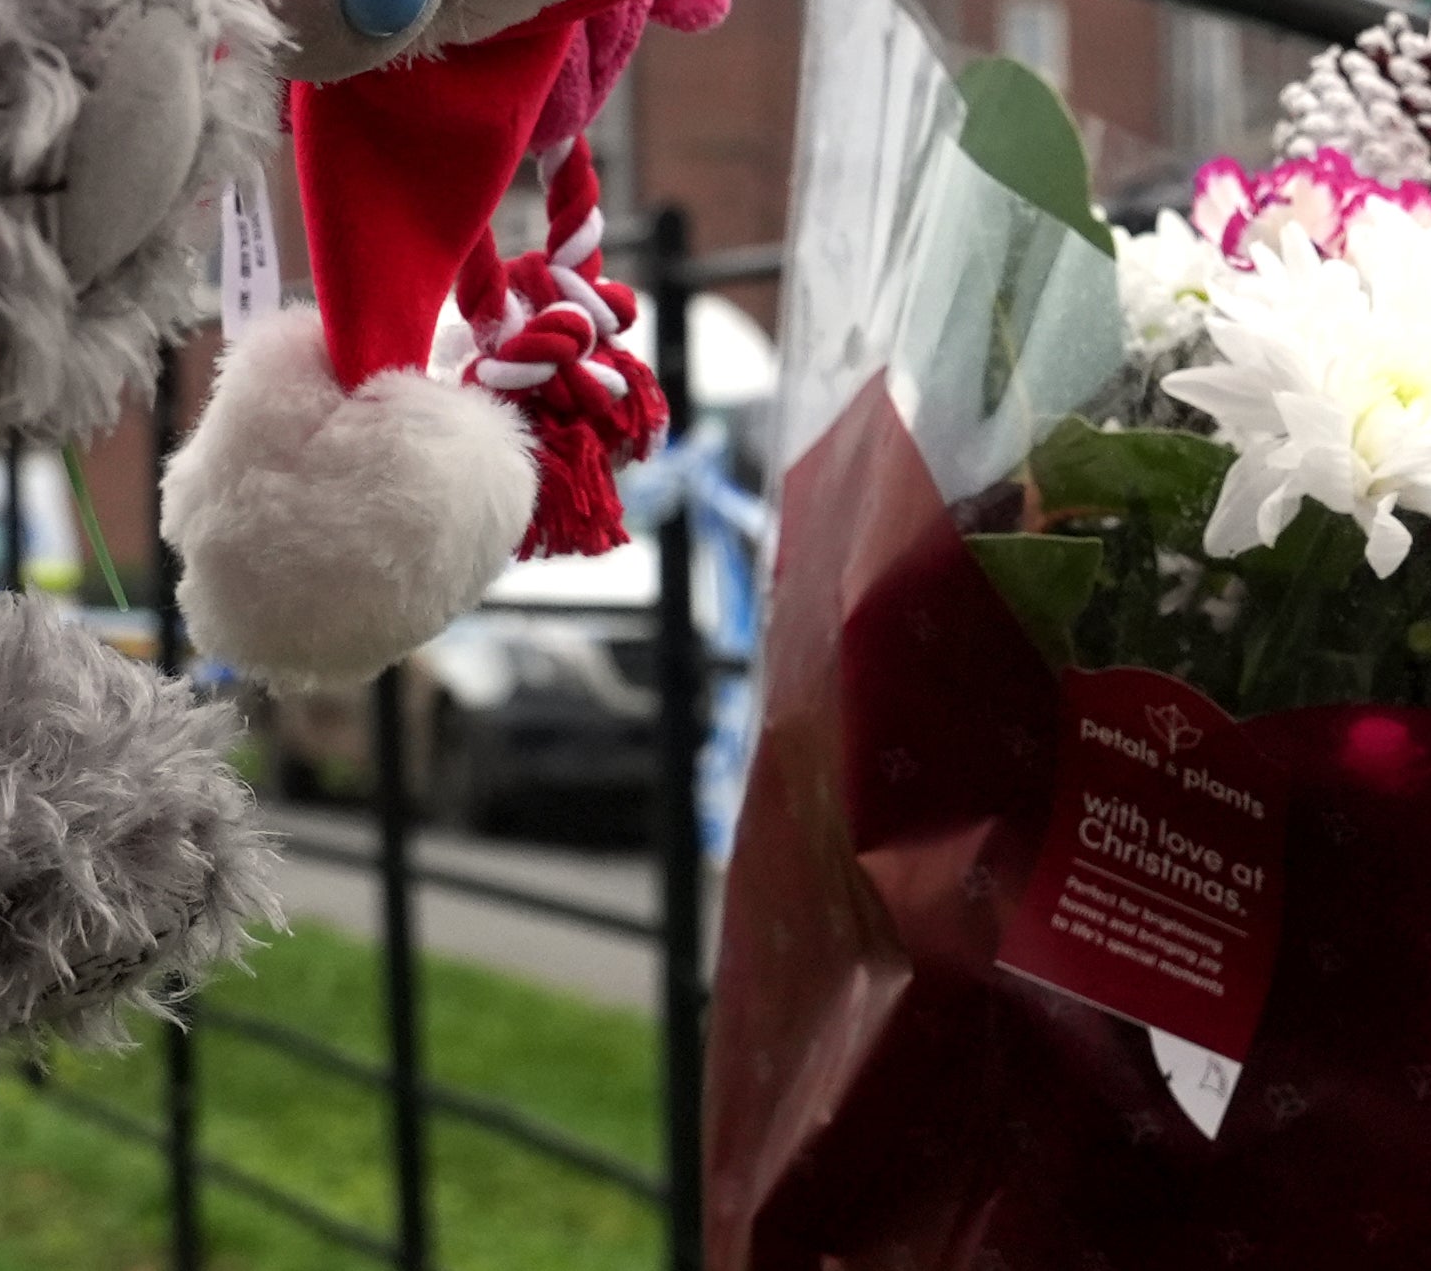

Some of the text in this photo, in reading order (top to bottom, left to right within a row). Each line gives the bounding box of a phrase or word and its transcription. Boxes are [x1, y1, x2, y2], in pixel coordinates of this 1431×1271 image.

[1081, 716, 1159, 769] petals
[1183, 765, 1266, 821] plants
[1077, 815, 1248, 918] Christmas.
[1082, 791, 1266, 894] with love at
